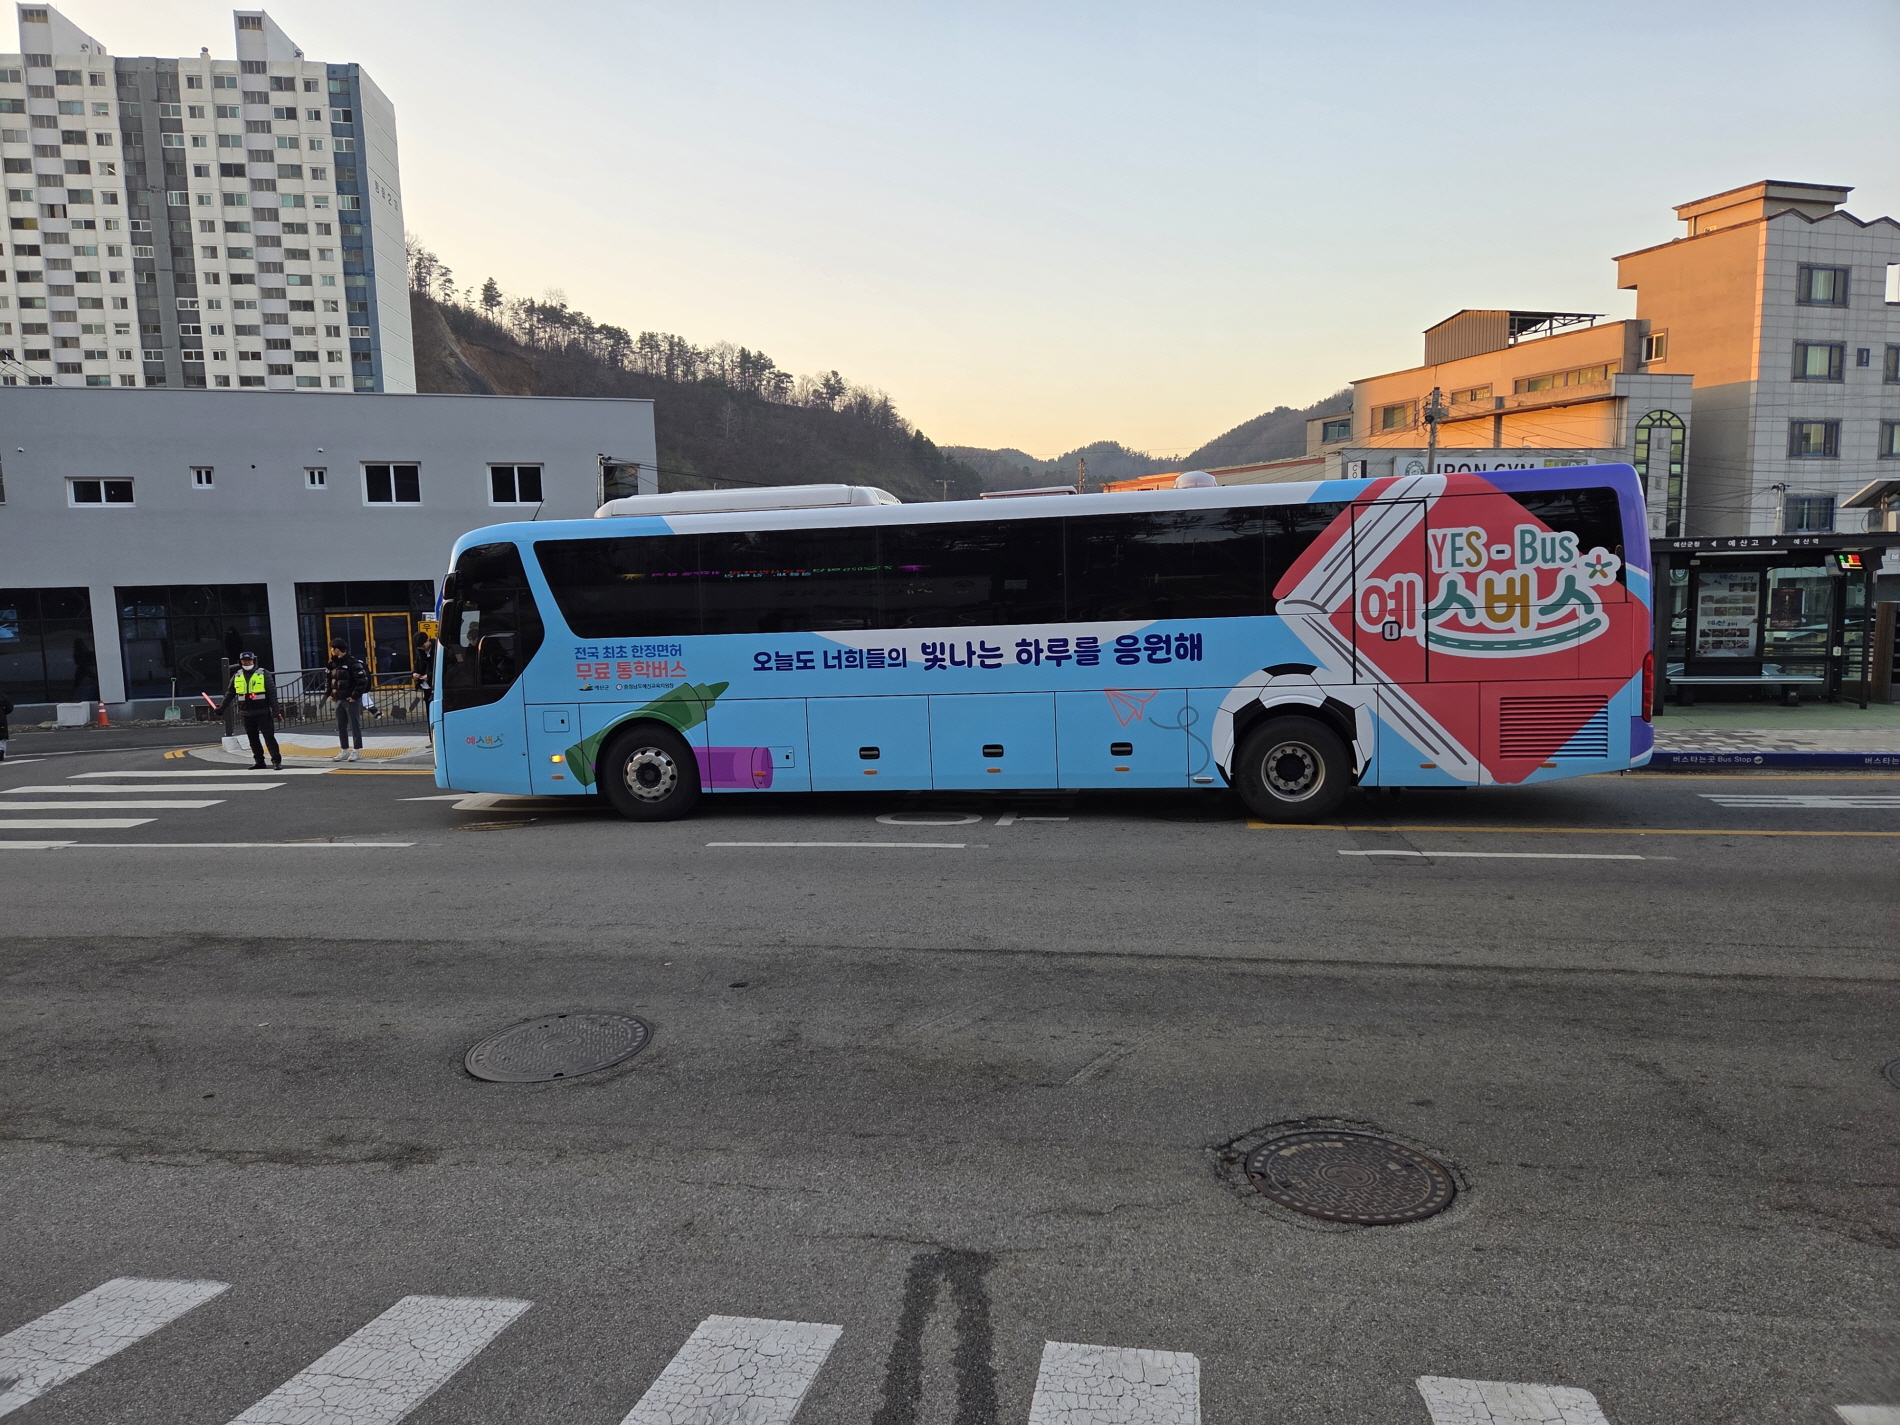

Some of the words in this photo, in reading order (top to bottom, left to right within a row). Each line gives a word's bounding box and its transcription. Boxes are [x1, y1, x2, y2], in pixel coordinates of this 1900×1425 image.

[1727, 539, 1759, 547] 예산고
[1360, 573, 1602, 651] 예스버스
[574, 646, 600, 660] 전국
[602, 645, 628, 659] 최초
[630, 643, 682, 659] 한정면허
[753, 650, 816, 672] 오늘도
[822, 647, 908, 671] 너희들의
[920, 641, 1003, 672] 빛나는
[1014, 636, 1102, 668] 하루를
[1113, 632, 1203, 666] 응원해
[576, 662, 611, 681] 무료
[616, 660, 687, 680] 통학버스
[465, 735, 504, 749] 예스버스
[1672, 755, 1716, 764] 버스타는곳
[1717, 755, 1732, 763] Bus
[1734, 755, 1752, 764] Stop
